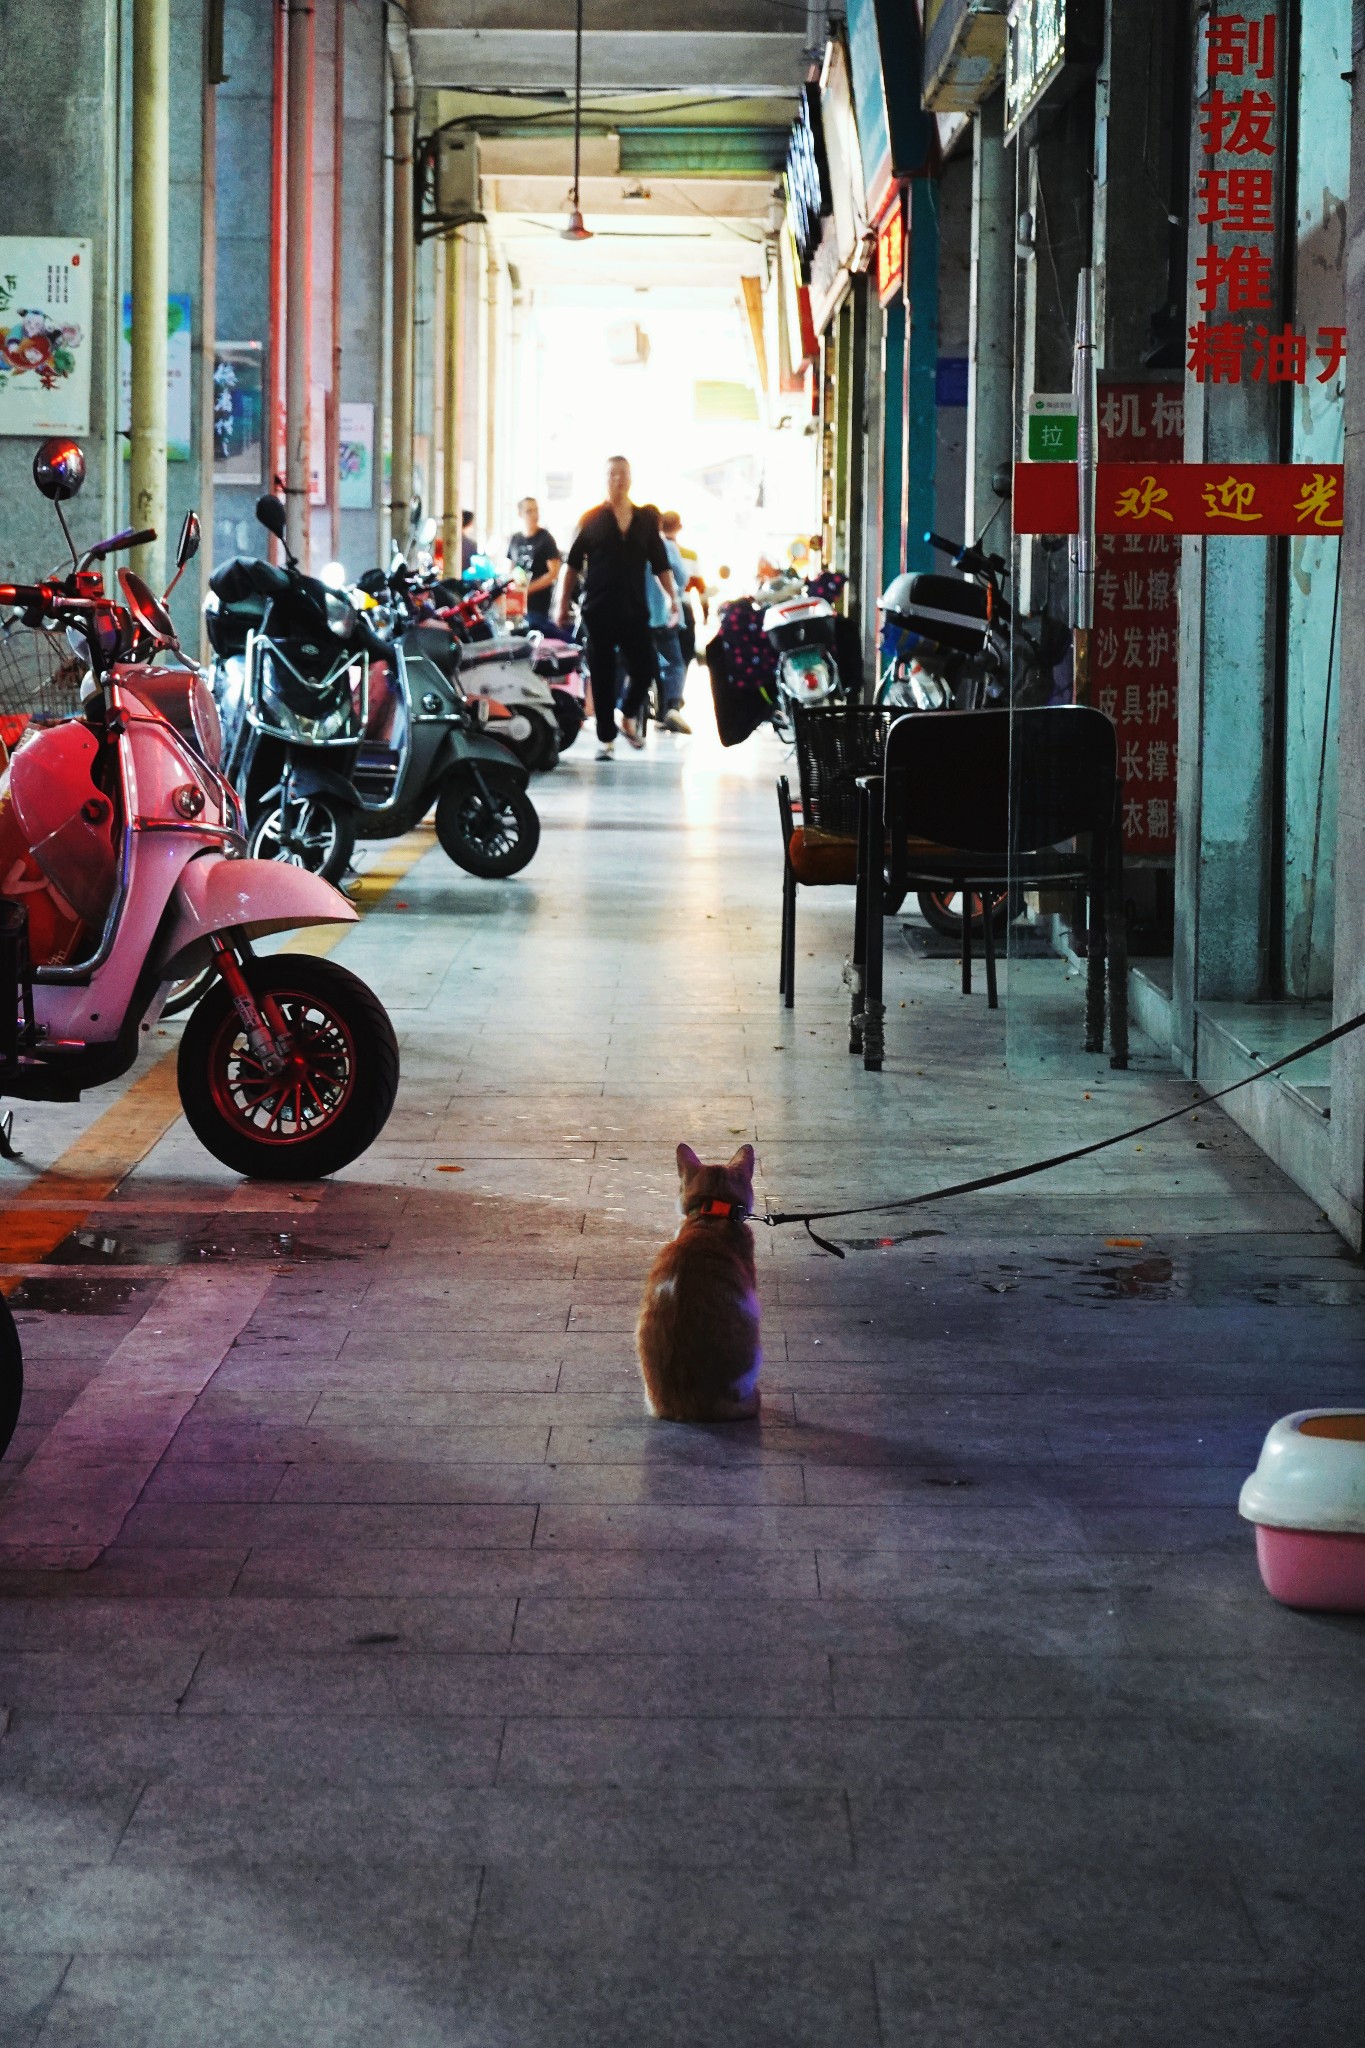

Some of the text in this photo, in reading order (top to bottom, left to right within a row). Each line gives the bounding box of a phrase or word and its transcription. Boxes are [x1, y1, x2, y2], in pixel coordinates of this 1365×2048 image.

[1041, 425, 1063, 446] 拉
[1114, 472, 1343, 527] 欢迎光
[1098, 684, 1178, 727] 皮具护
[1122, 797, 1177, 839] 衣翻
